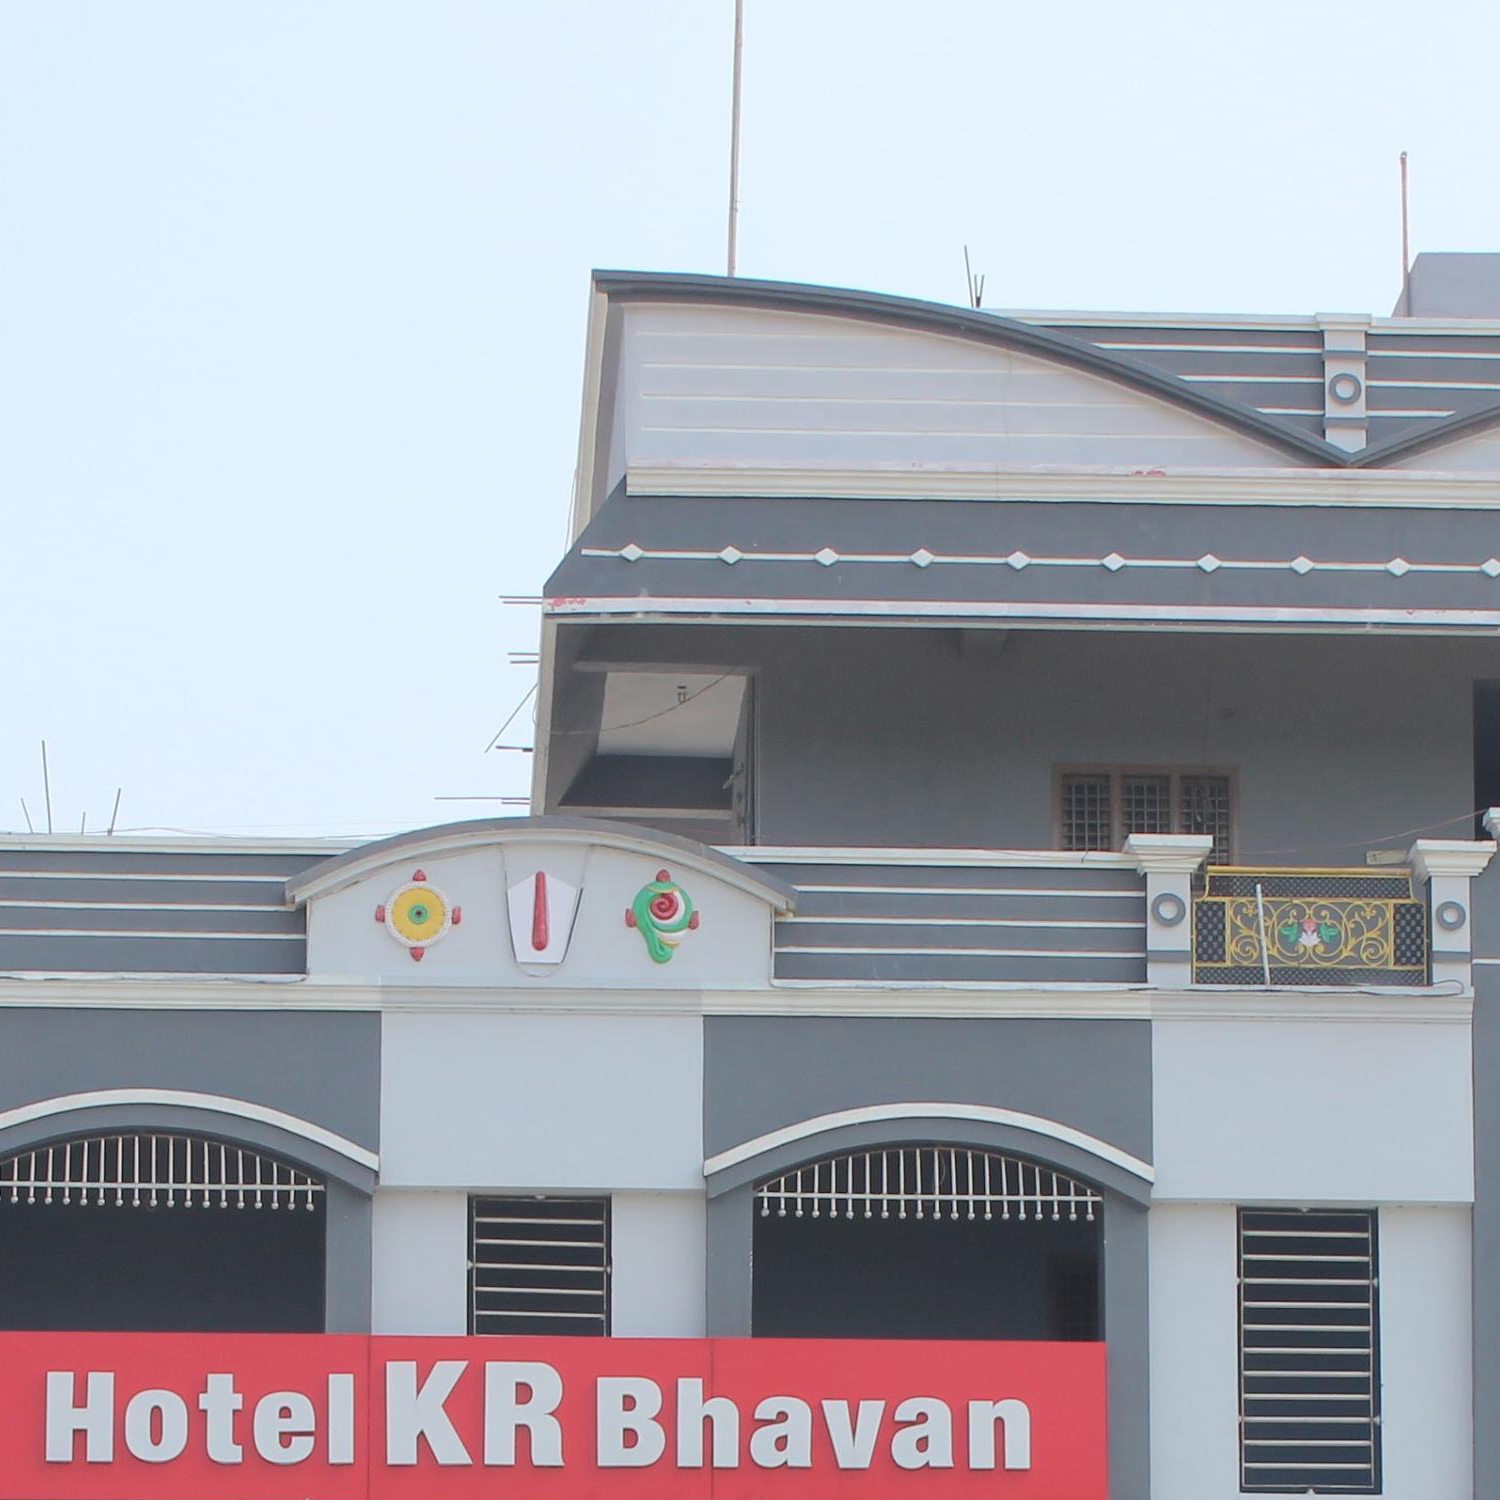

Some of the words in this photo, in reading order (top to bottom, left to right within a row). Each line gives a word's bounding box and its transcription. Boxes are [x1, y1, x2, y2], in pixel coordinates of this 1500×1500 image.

[44, 1370, 354, 1466] Hotel
[385, 1358, 565, 1468] KR
[597, 1375, 1032, 1472] Bhavan
